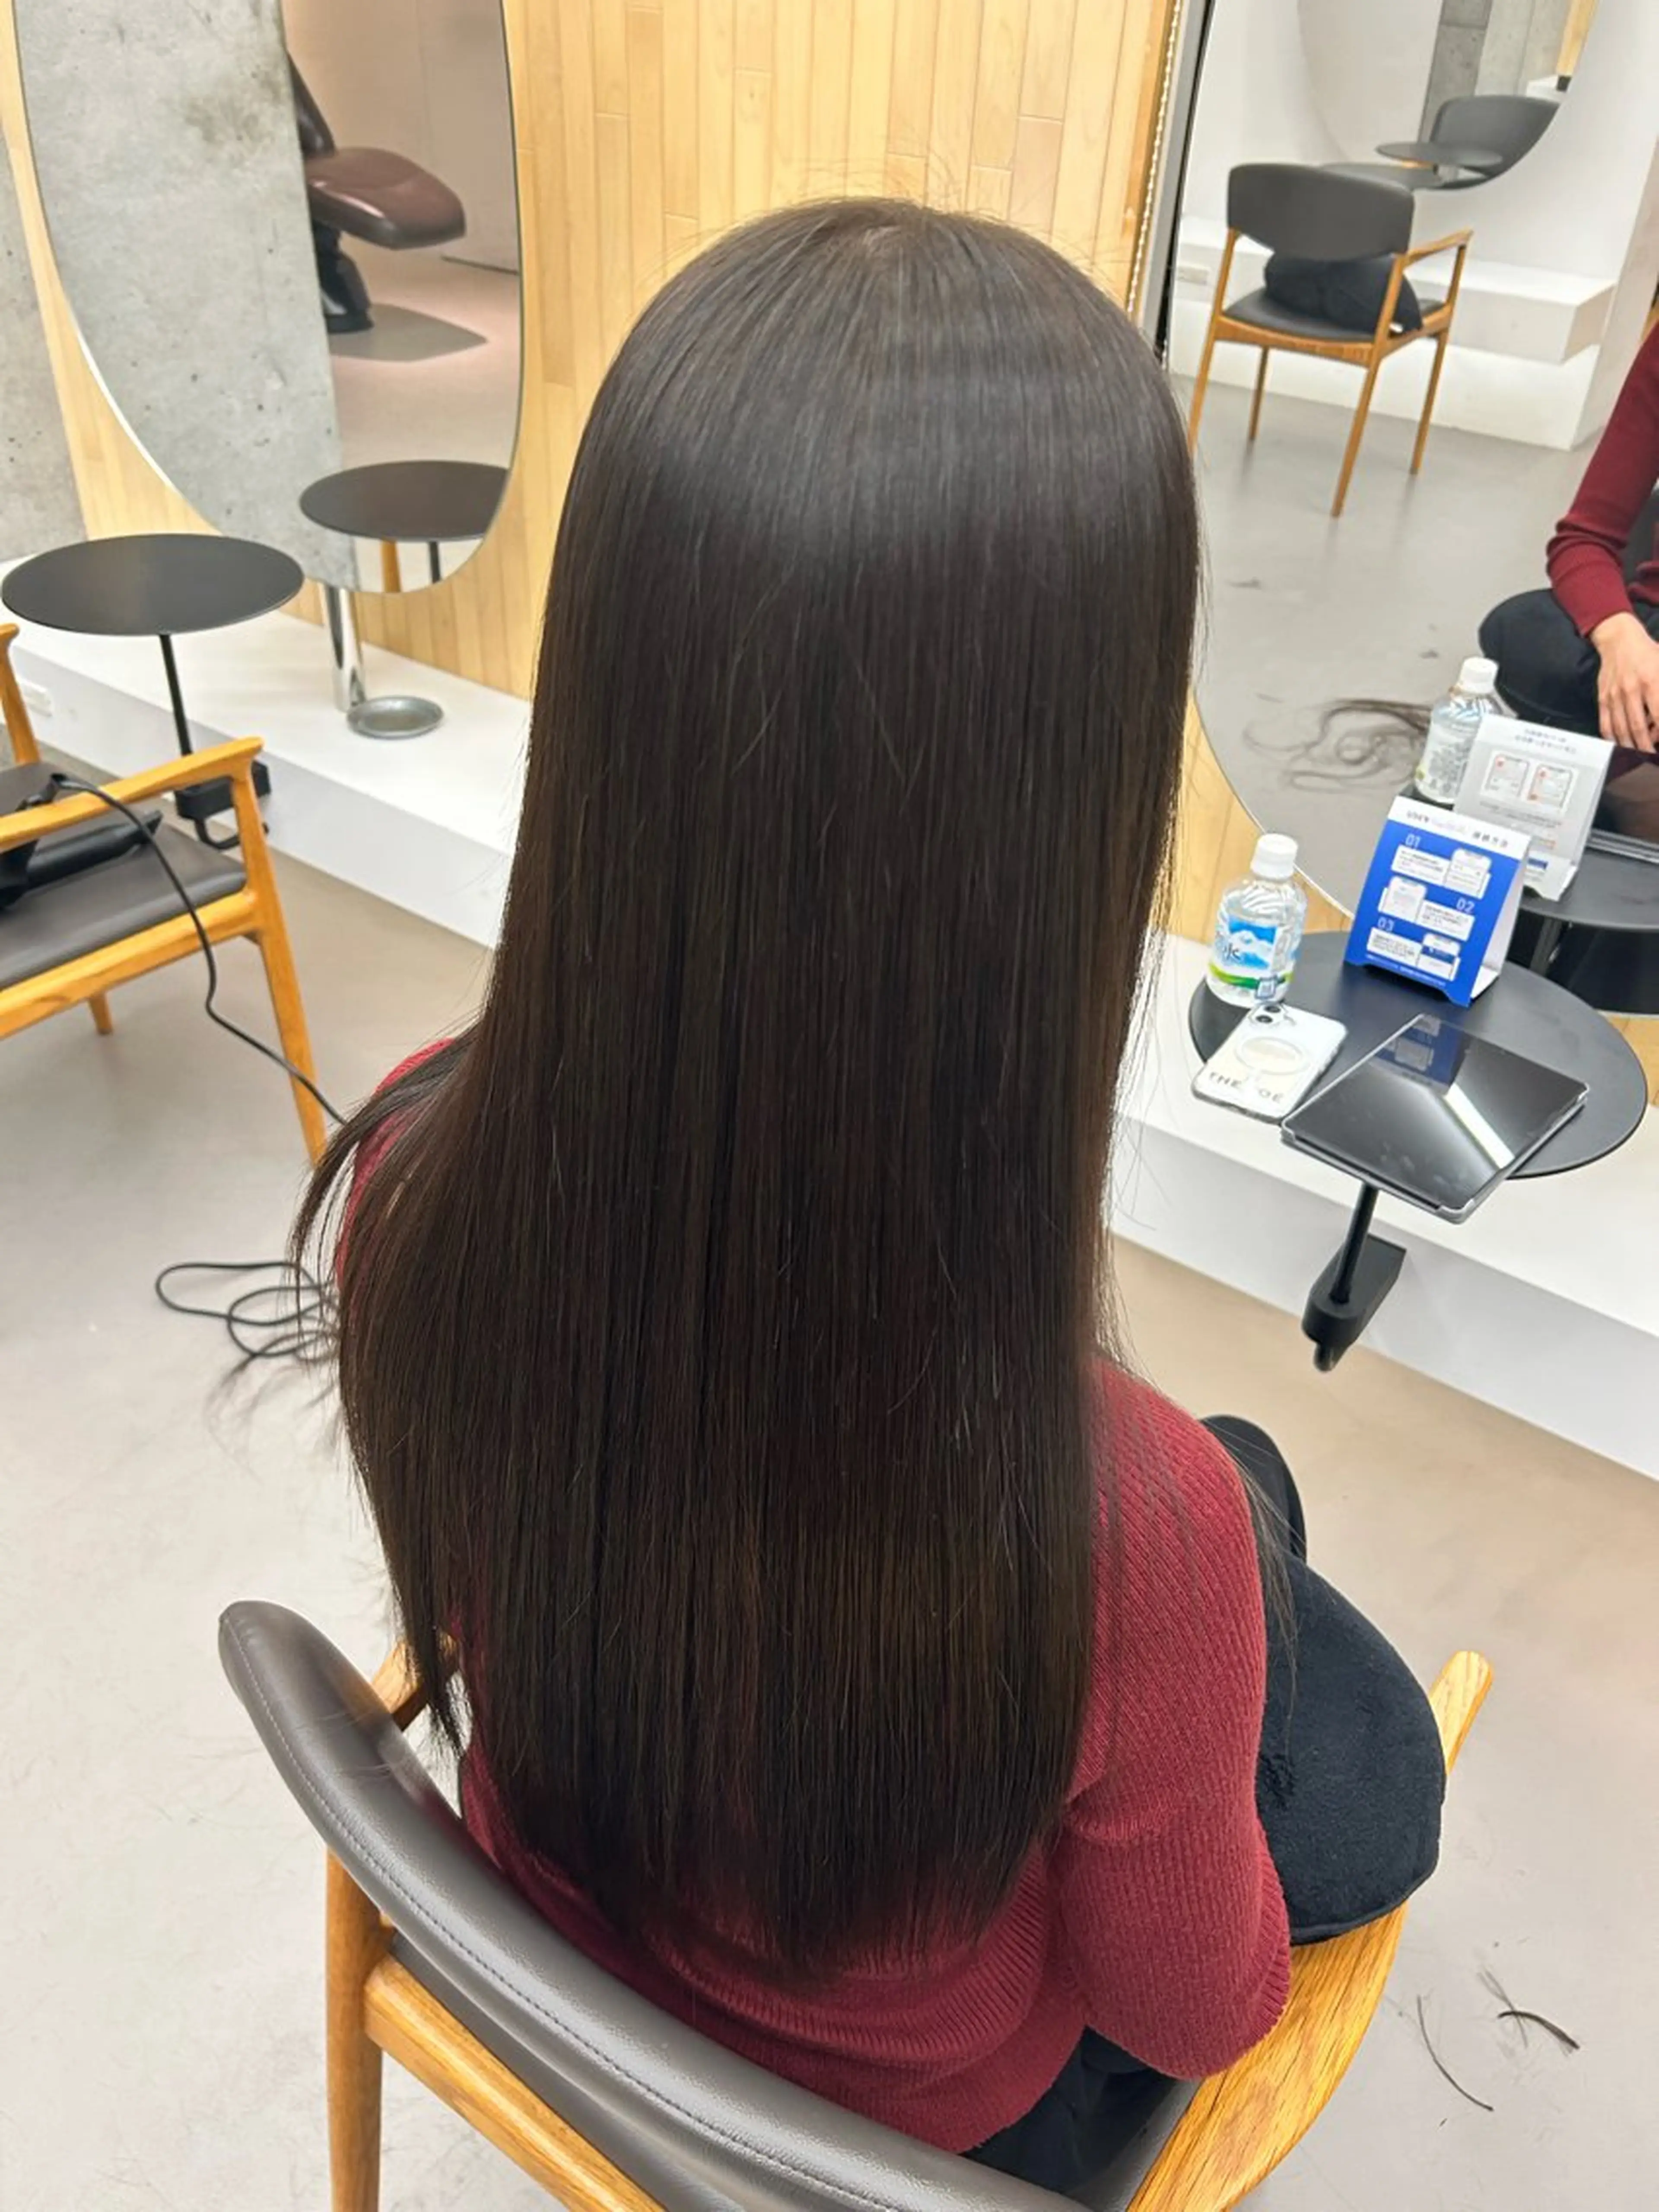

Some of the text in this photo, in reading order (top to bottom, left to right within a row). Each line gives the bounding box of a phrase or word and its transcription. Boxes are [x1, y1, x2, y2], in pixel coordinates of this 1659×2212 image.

[1405, 834, 1421, 849] 01
[1456, 897, 1475, 912] 02
[1377, 917, 1395, 931] 03
